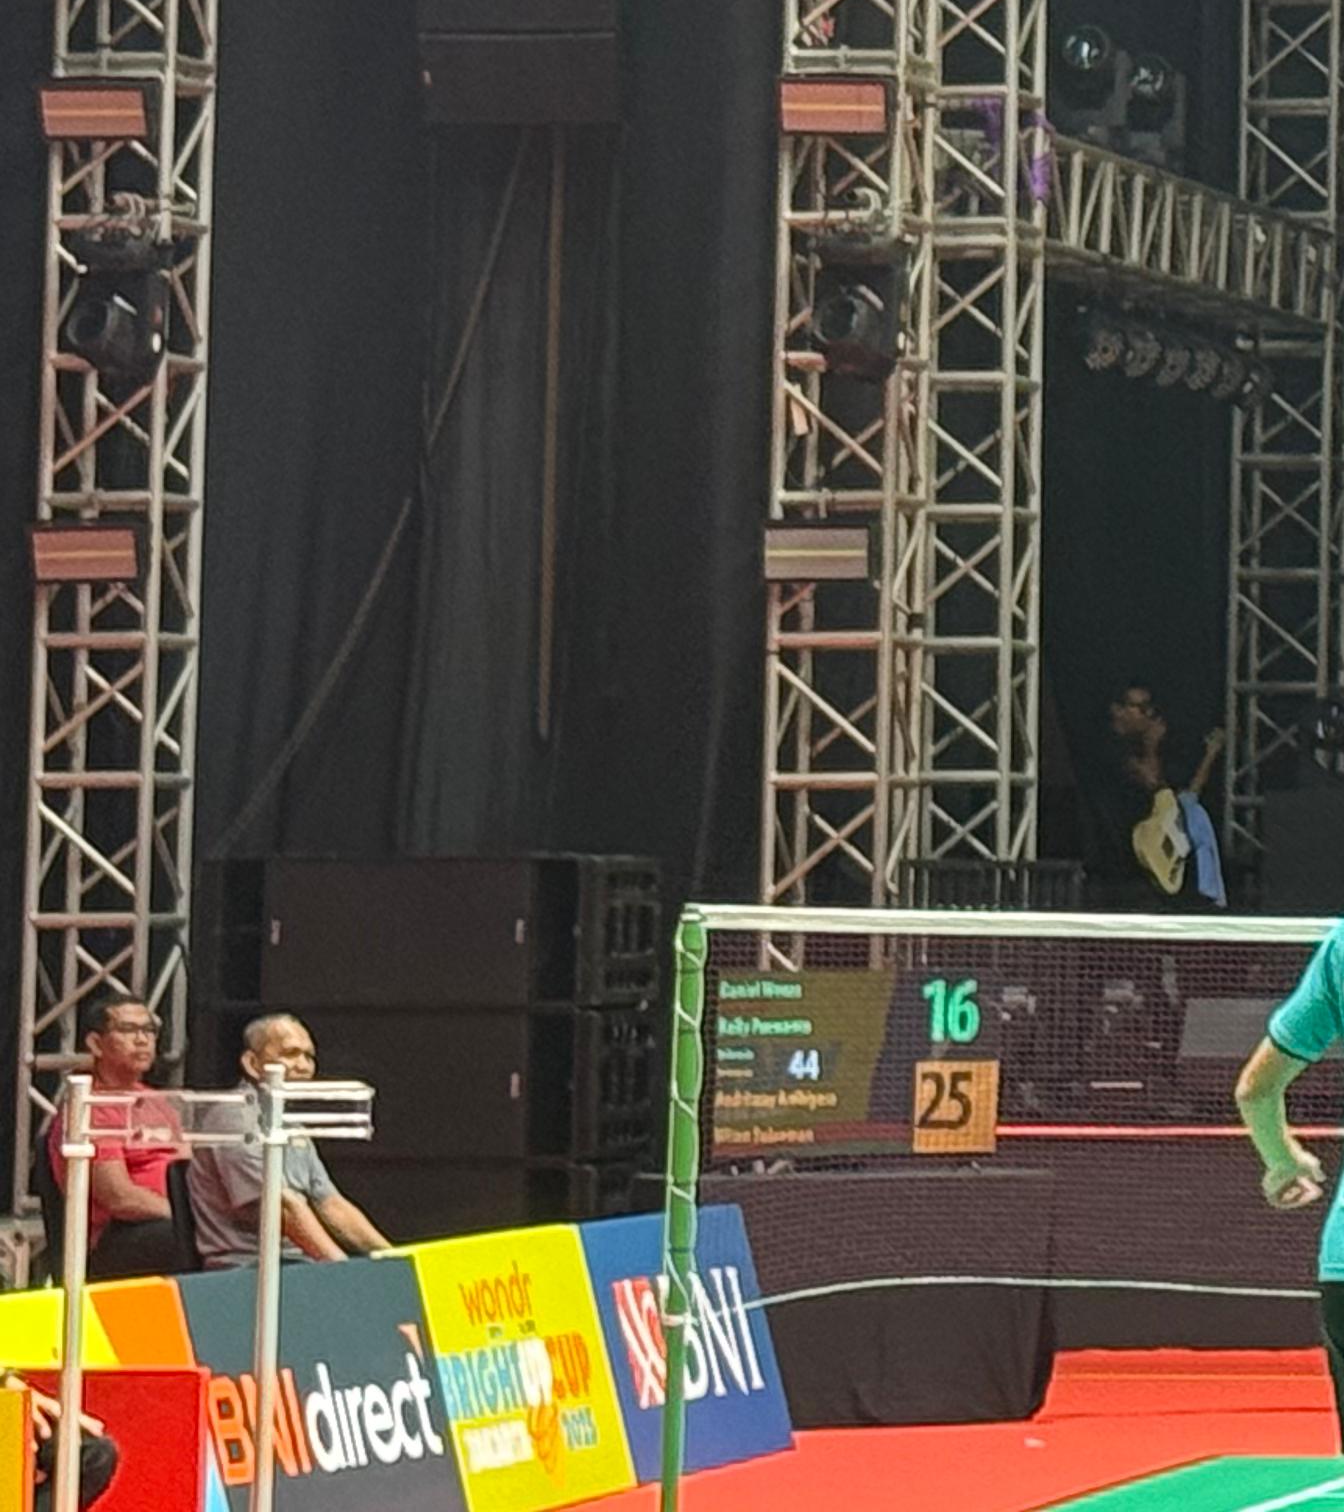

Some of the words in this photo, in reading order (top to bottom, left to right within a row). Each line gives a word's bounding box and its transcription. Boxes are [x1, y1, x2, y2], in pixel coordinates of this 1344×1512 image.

[922, 979, 980, 1042] 16
[787, 1049, 820, 1080] 44
[915, 1071, 974, 1129] 25
[458, 1260, 532, 1326] wondr
